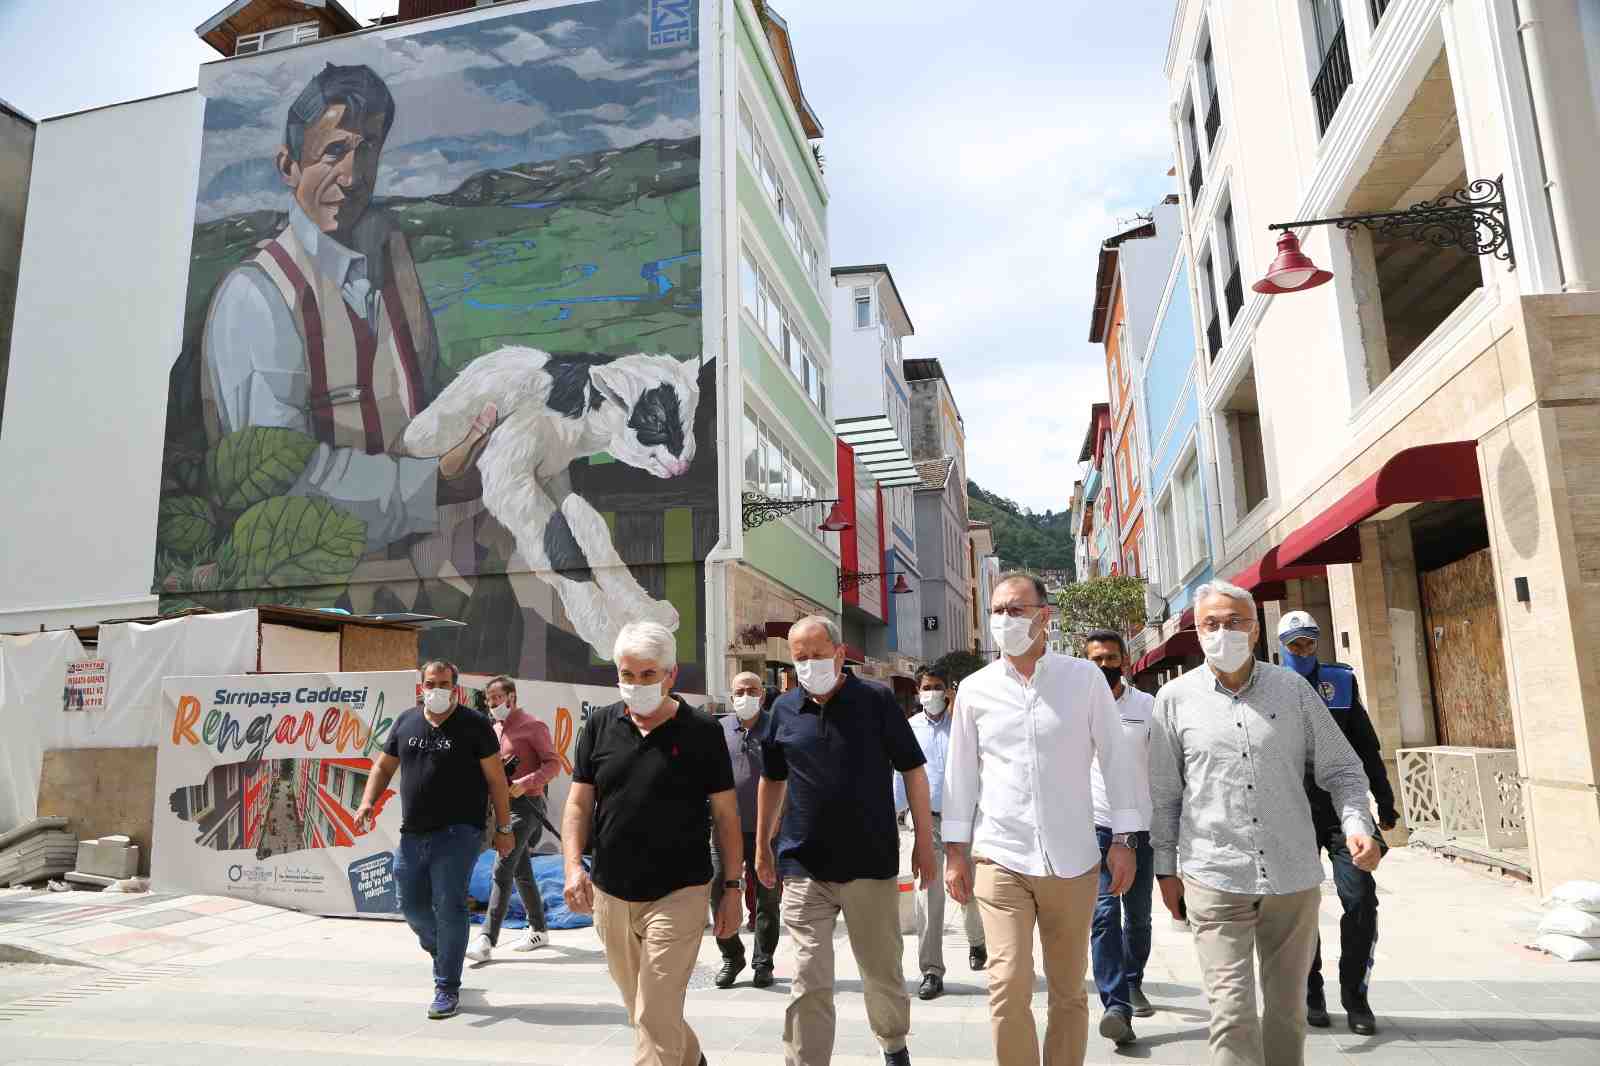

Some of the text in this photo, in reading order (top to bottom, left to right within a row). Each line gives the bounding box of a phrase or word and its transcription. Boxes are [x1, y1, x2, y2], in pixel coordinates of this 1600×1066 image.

[213, 686, 369, 708] Sırrıpaşa Caddesi
[172, 690, 394, 764] Rengarenk
[408, 736, 452, 750] GUSS
